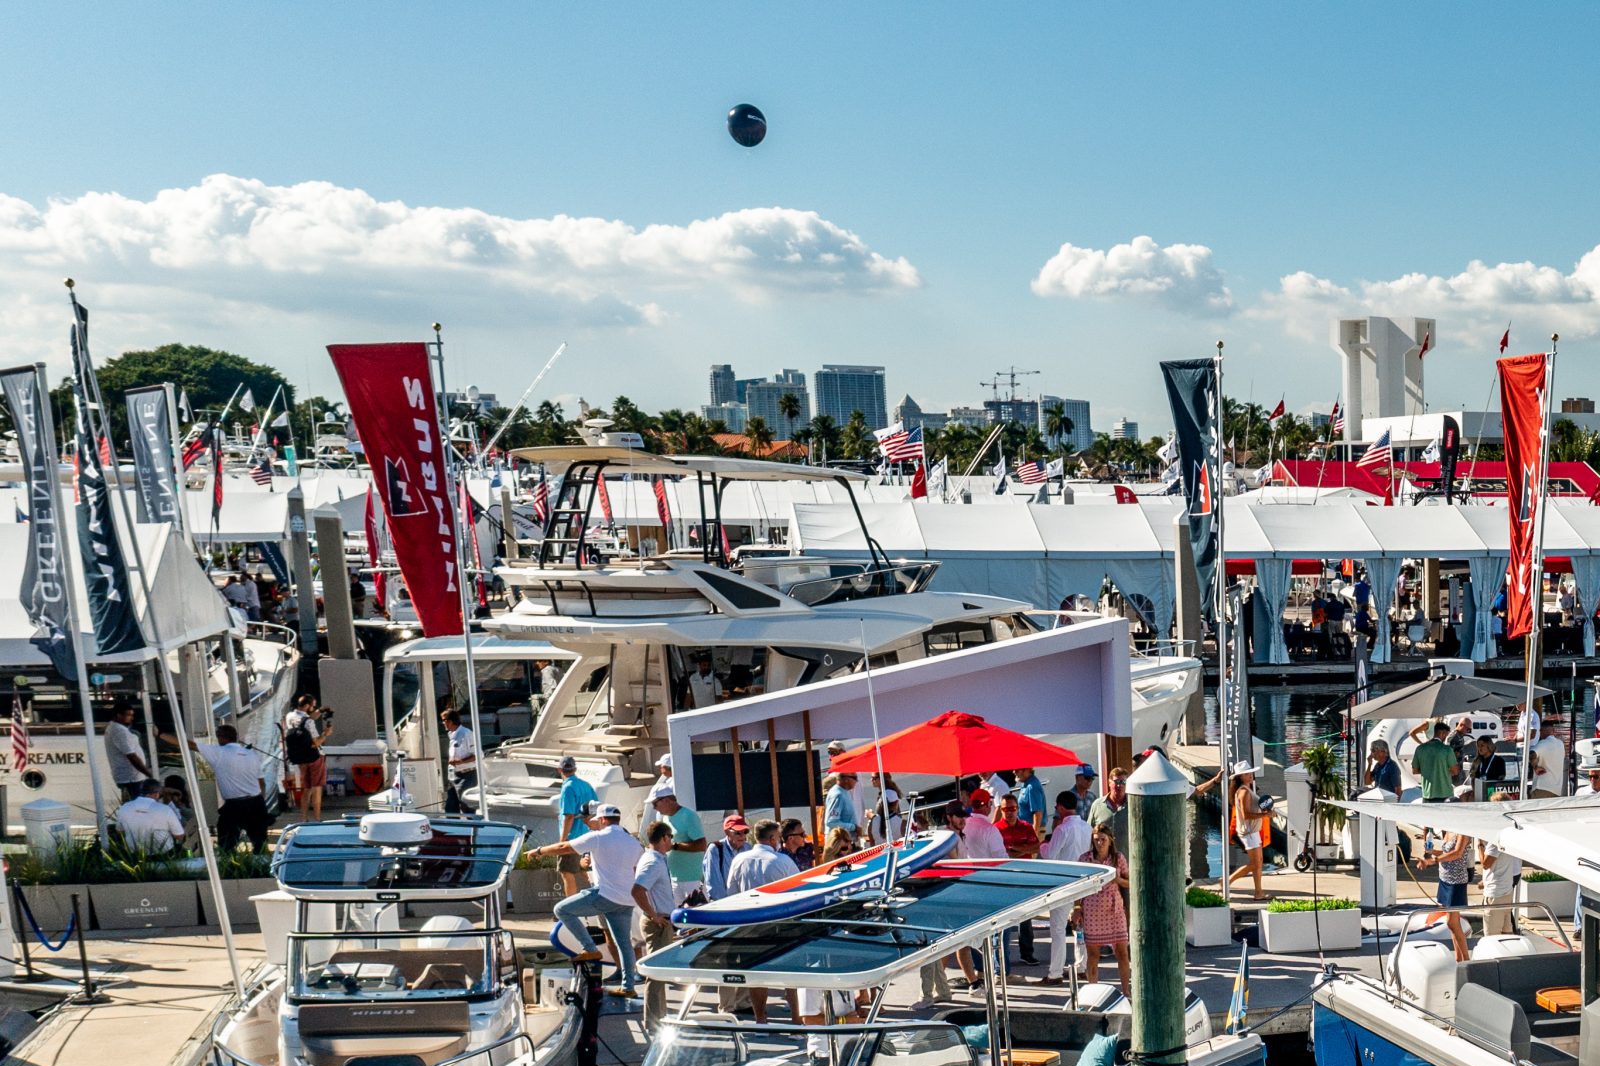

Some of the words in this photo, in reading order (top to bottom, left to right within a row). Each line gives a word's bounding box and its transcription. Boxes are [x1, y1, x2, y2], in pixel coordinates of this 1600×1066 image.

[402, 376, 457, 592] NIMBUS
[521, 625, 563, 634] GREENLINE
[566, 626, 574, 634] 45
[27, 752, 86, 765] REAMER
[1494, 785, 1521, 794] ITALIA
[824, 865, 912, 904] NIMBS
[351, 1008, 417, 1017] NIMBUS
